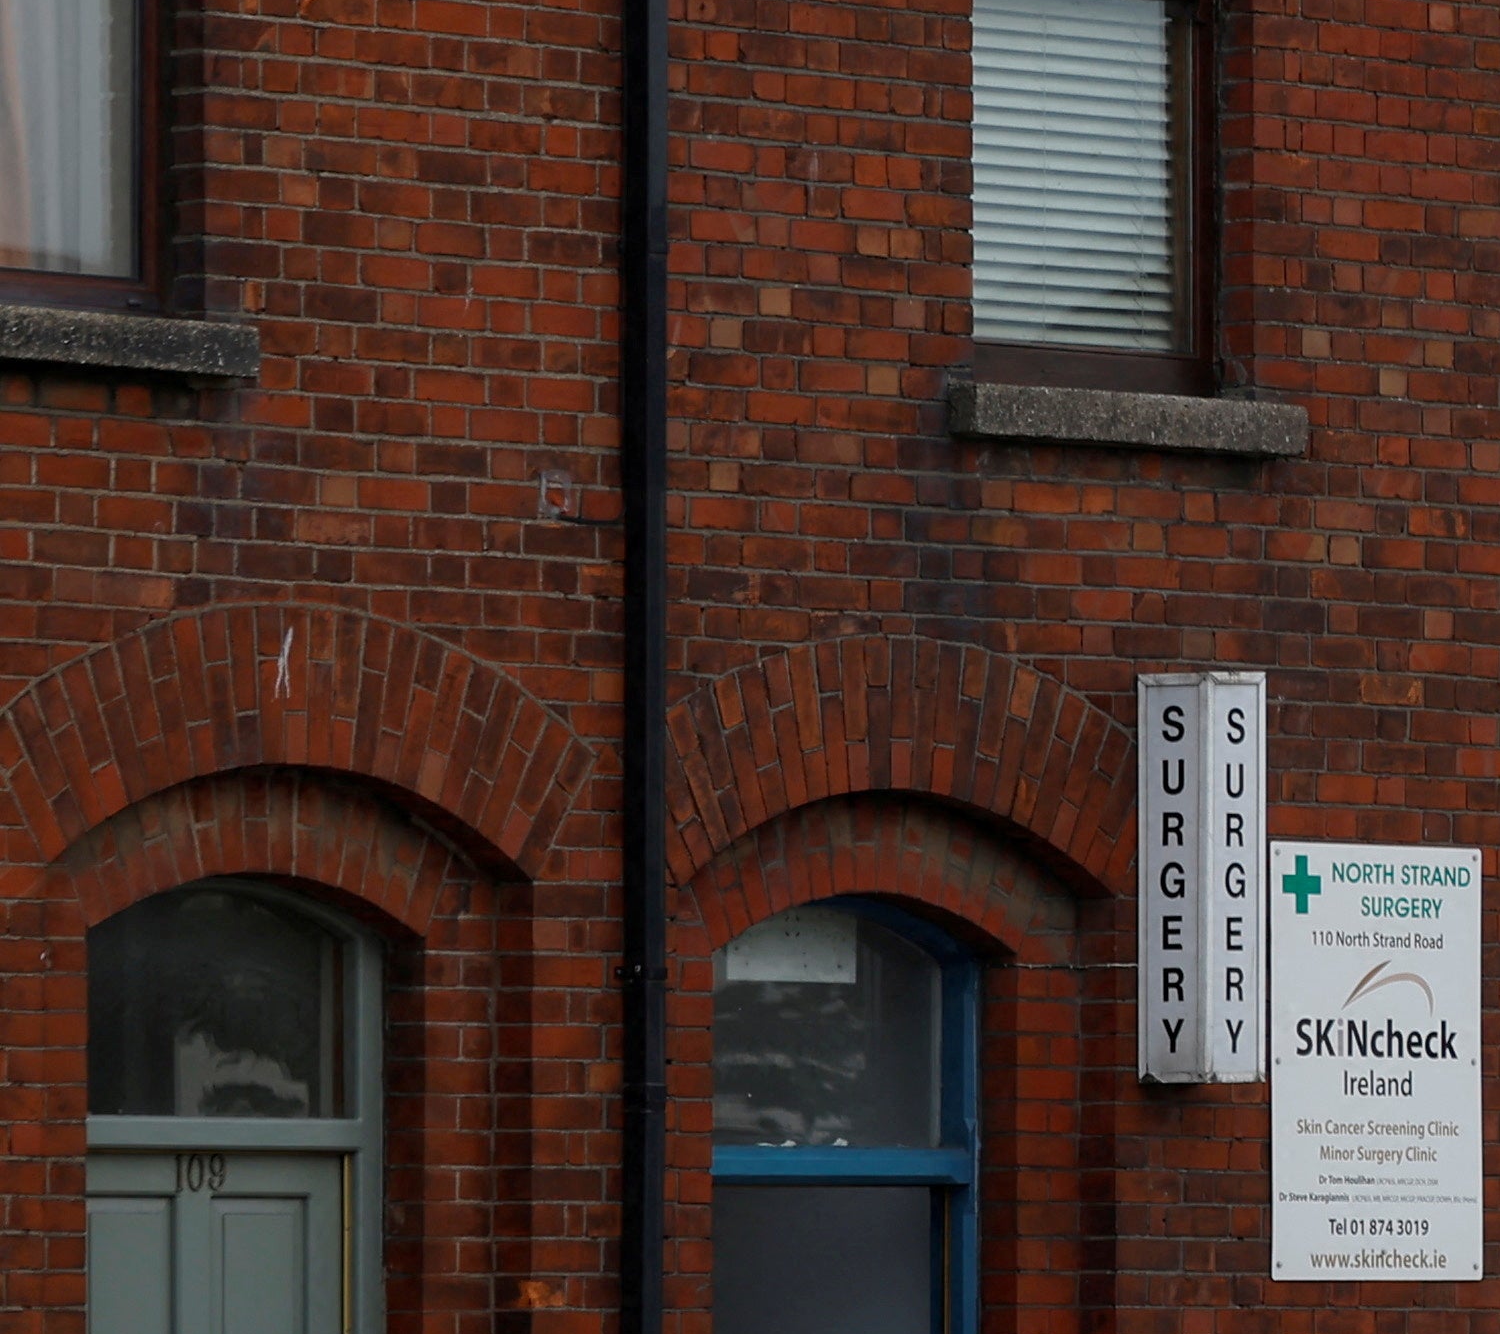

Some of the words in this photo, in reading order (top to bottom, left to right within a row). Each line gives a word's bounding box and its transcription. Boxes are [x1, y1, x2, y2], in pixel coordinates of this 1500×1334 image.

[1160, 705, 1186, 1054] SURGERY
[1225, 707, 1246, 1054] SURGERY
[1332, 862, 1395, 884] NORTH
[1401, 865, 1471, 887] STRAND
[1361, 896, 1443, 918] SURGERY
[1312, 931, 1333, 946] 110
[1336, 931, 1370, 948] North
[1373, 932, 1411, 949] Strand
[1414, 934, 1444, 950] Road
[1343, 1069, 1413, 1096] Ireland
[1297, 1119, 1322, 1134] Skin
[1325, 1119, 1364, 1135] Cancer
[1367, 1120, 1425, 1139] Screening
[1427, 1121, 1459, 1136] Clinic
[1319, 1145, 1354, 1161] Minor
[1357, 1146, 1403, 1164] Surgery
[1405, 1147, 1438, 1162] Clinic
[175, 1153, 226, 1193] 109
[1319, 1174, 1327, 1184] Dr
[1328, 1175, 1343, 1184] Tom
[1344, 1175, 1375, 1185] Houlihan
[1280, 1192, 1287, 1201] Dr
[1288, 1192, 1308, 1202] Steve
[1329, 1219, 1347, 1235] Tel
[1350, 1220, 1365, 1235] 01
[1369, 1220, 1393, 1236] 874
[1396, 1219, 1429, 1236] 3019
[1311, 1249, 1447, 1269] www.skincheck.ie
